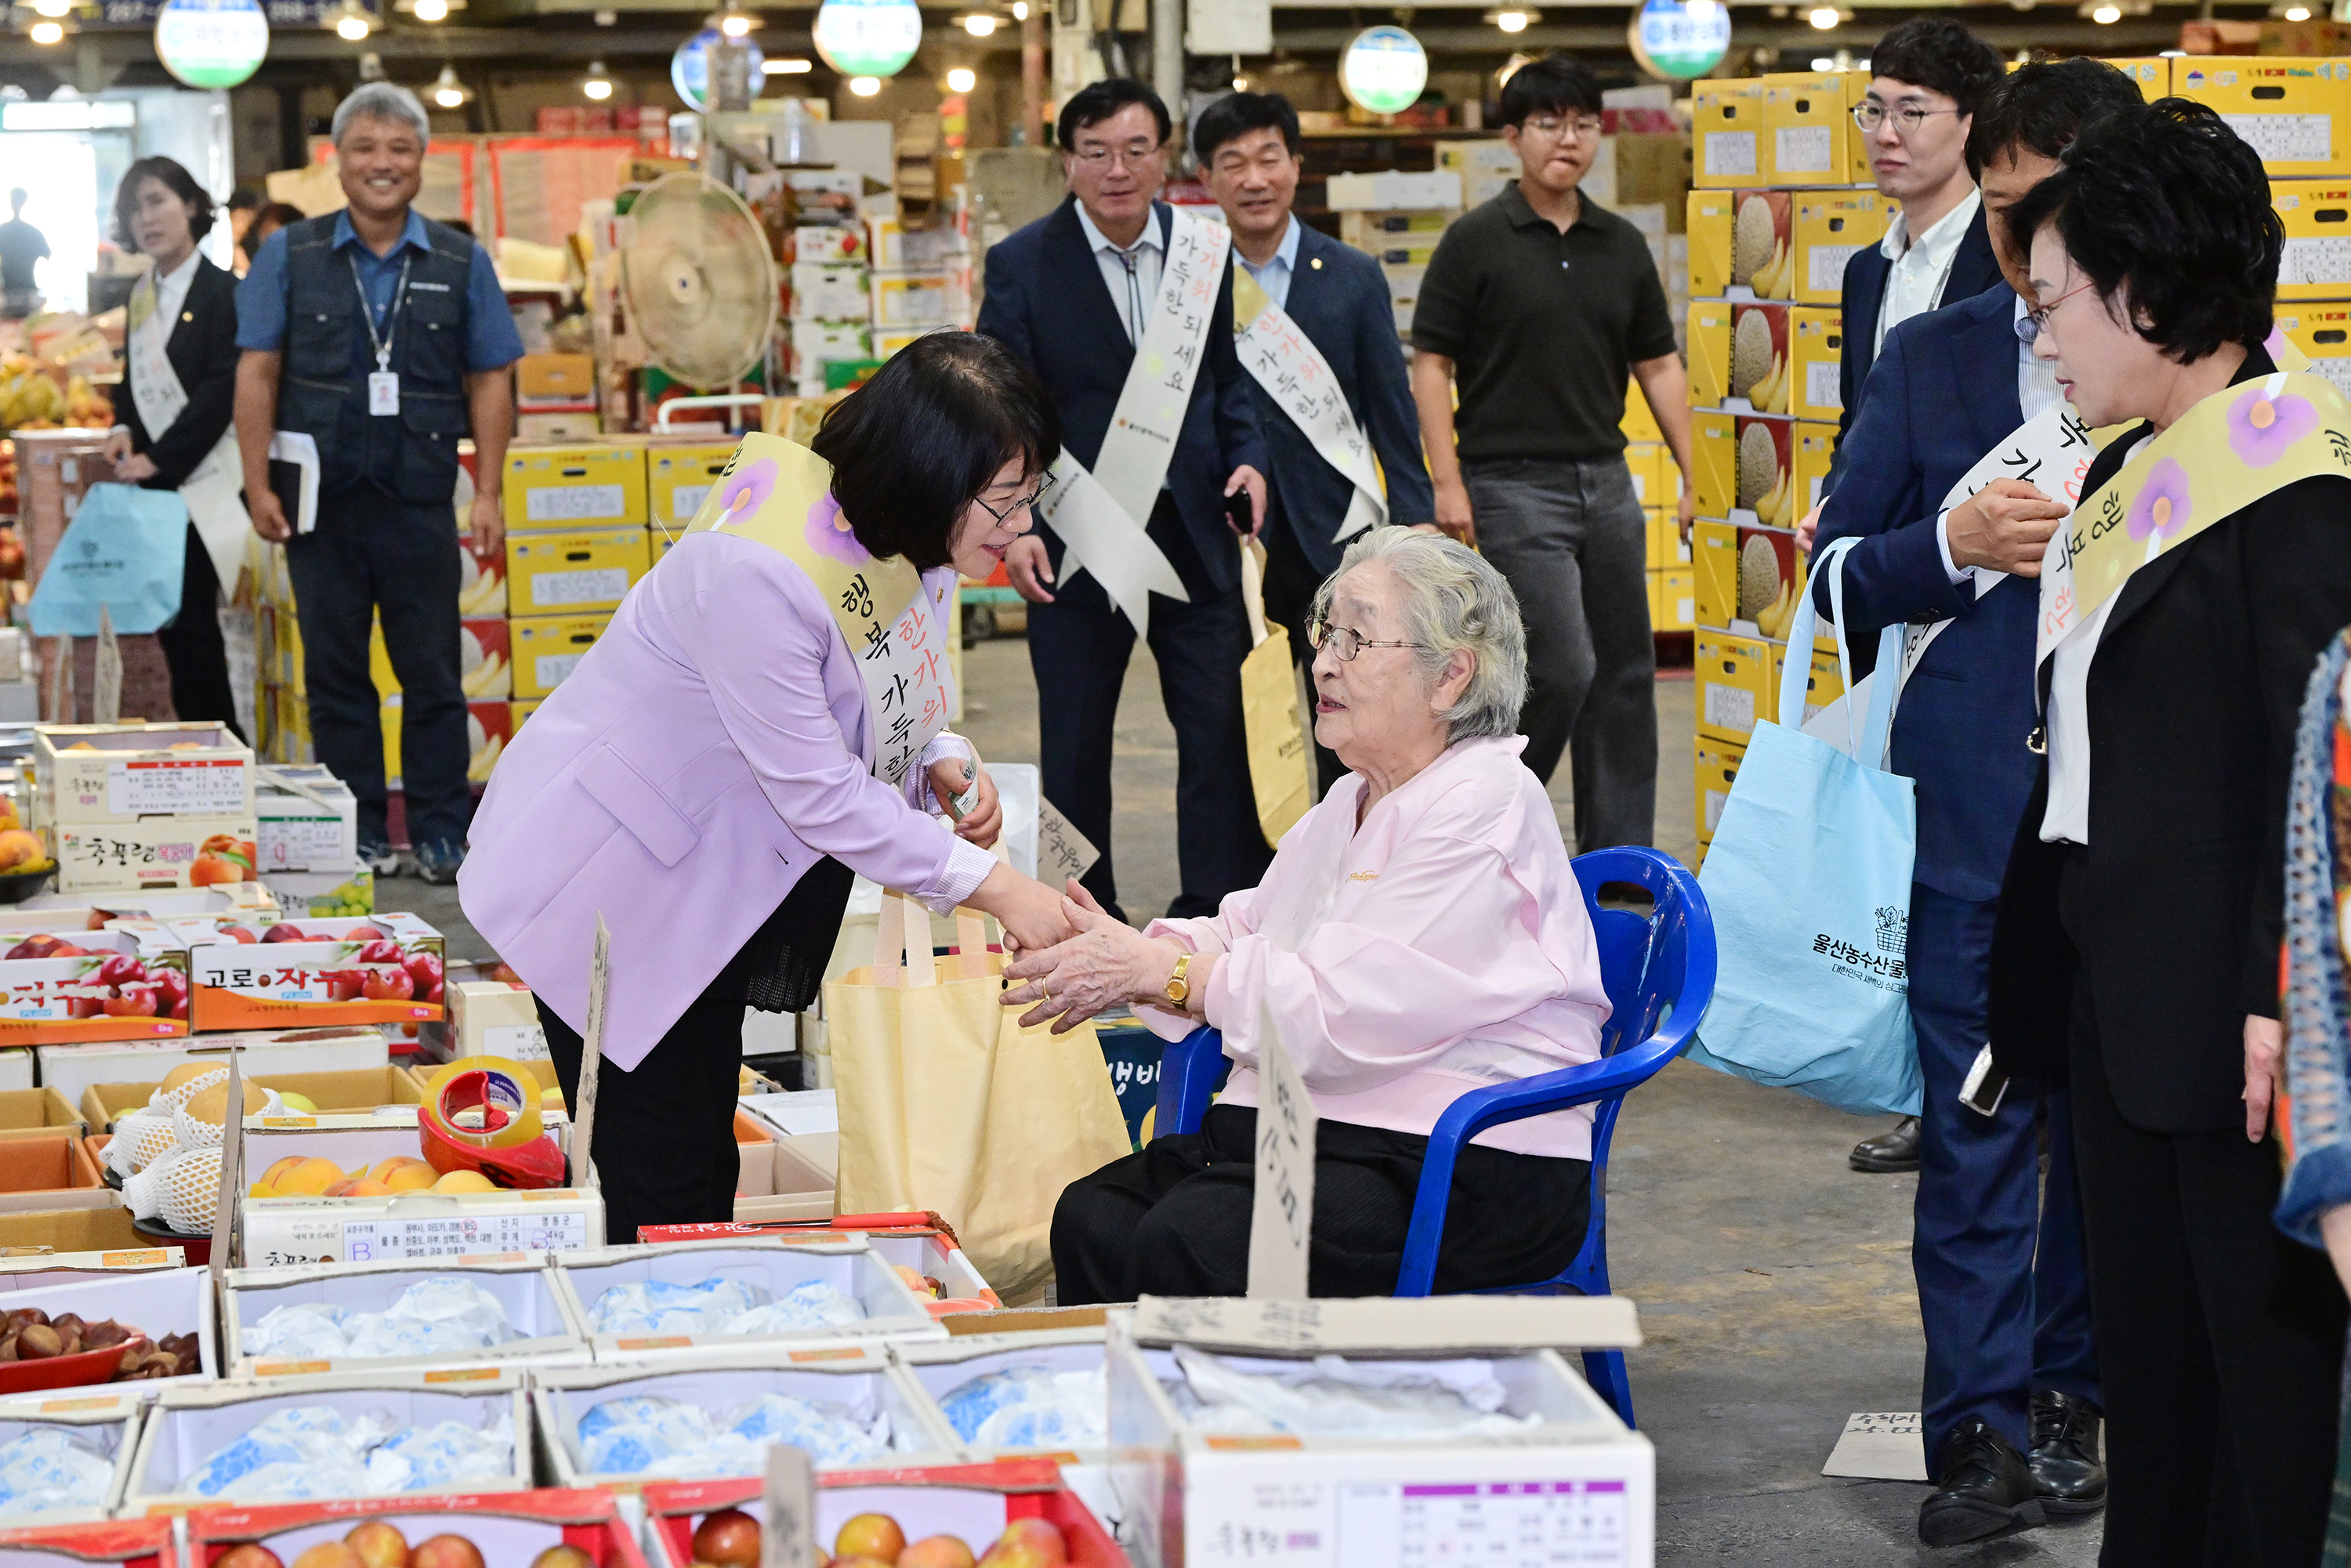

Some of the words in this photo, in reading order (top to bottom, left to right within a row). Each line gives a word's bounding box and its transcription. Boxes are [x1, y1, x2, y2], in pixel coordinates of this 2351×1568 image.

[1190, 224, 1224, 305] 한가위
[1164, 314, 1203, 392] 되세요
[1258, 311, 1324, 383] 한가위
[841, 573, 892, 661] 행복
[897, 607, 947, 729] 한가위
[203, 968, 254, 989] 고로
[1813, 933, 1908, 979] 울산농수산물
[1831, 963, 1864, 981] 대한민국
